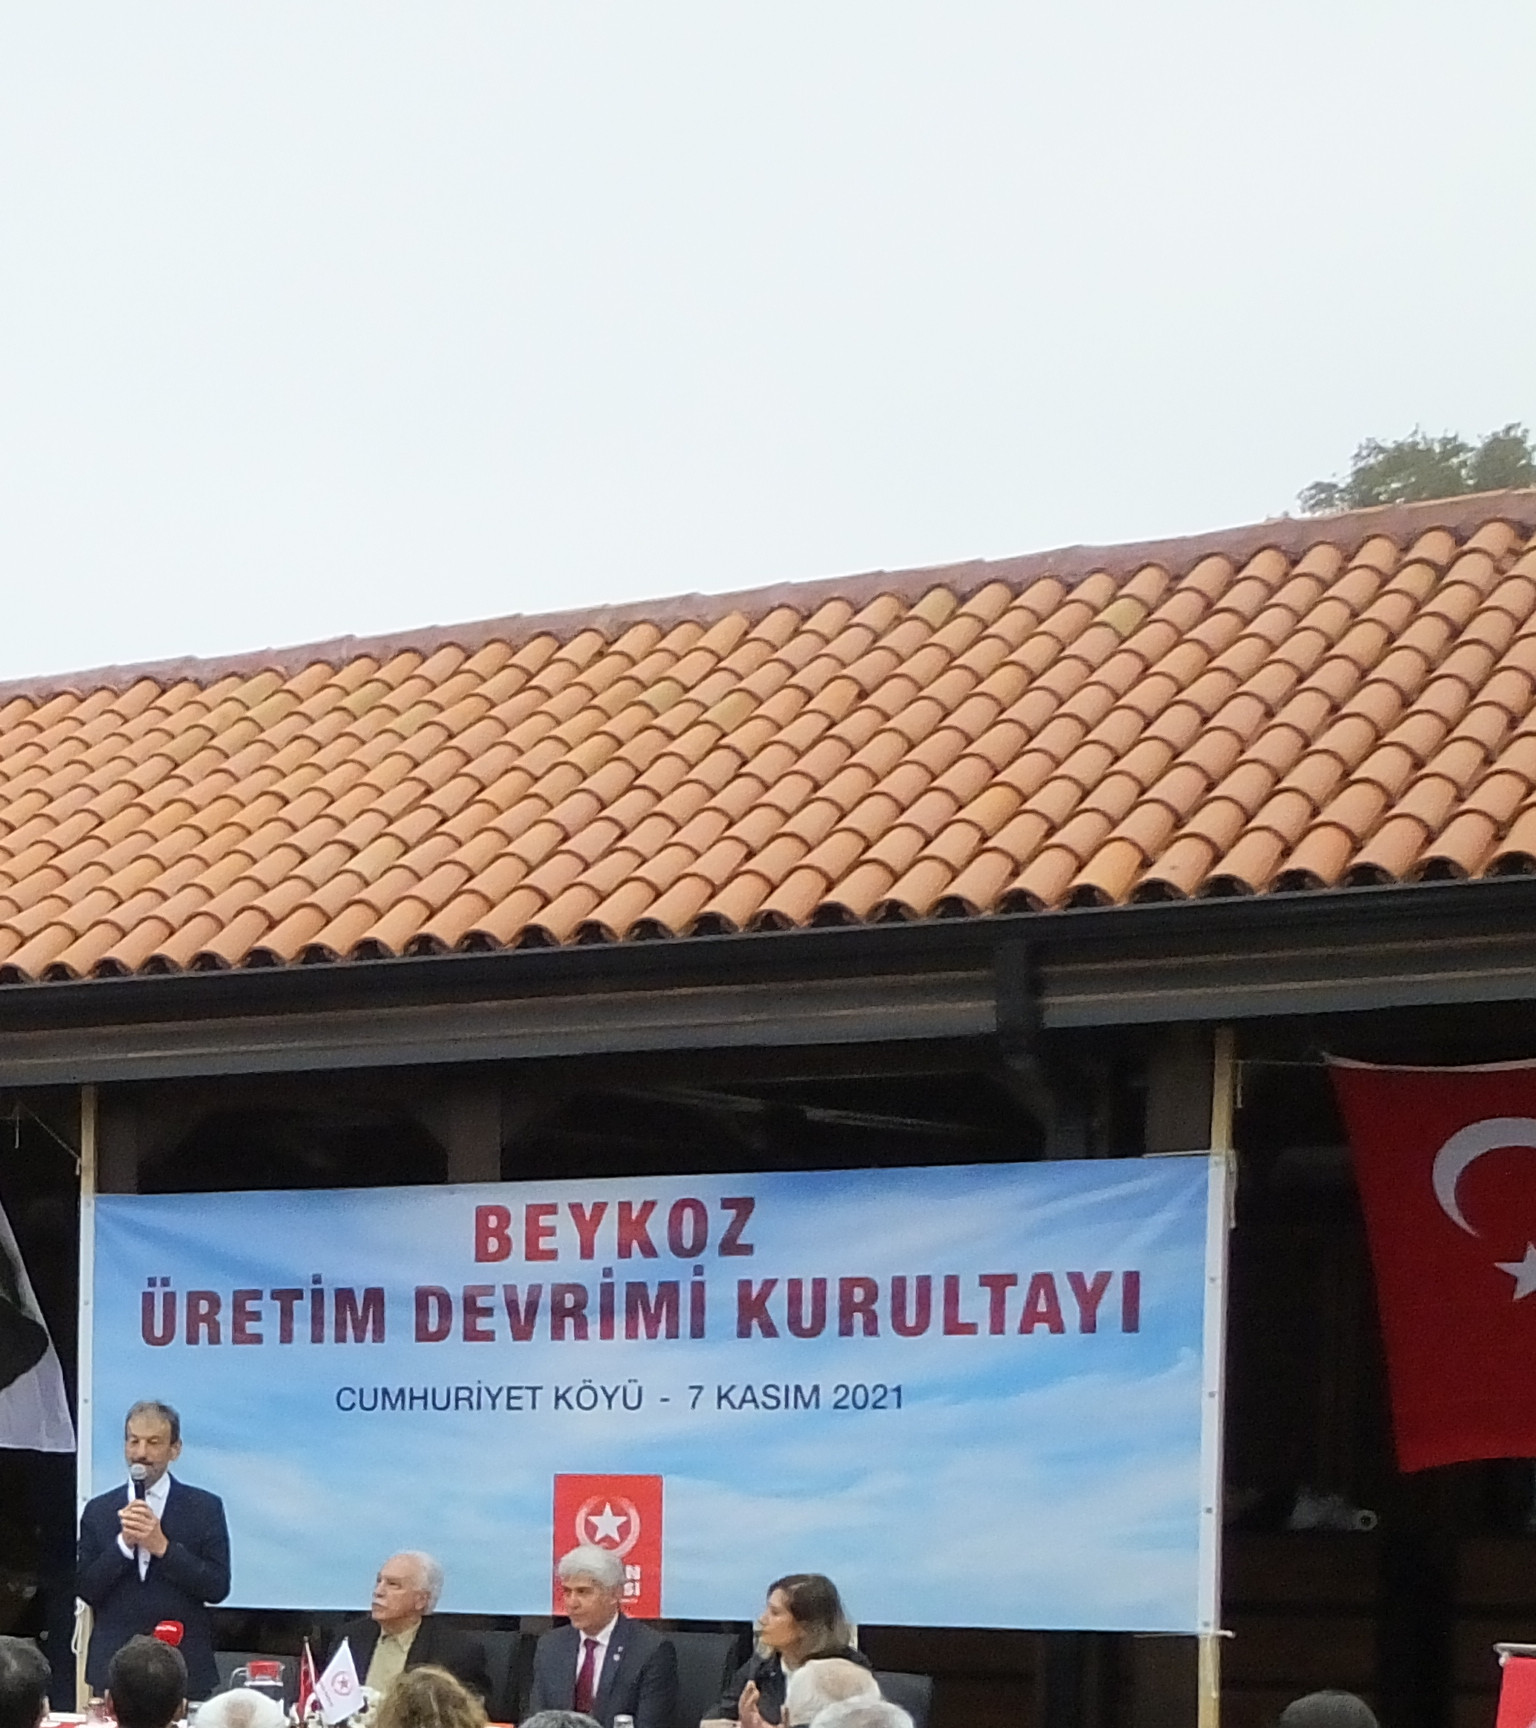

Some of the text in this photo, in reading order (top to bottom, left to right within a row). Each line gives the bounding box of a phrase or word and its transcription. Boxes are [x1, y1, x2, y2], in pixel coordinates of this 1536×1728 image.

[474, 1197, 756, 1263] BEYKOZ
[140, 1264, 1141, 1347] ÜRETİM DEVRİMİ KURULTAYI
[335, 1379, 544, 1413] CUMHURİYET
[554, 1378, 644, 1412] KÖYÜ
[688, 1384, 705, 1411] 7
[715, 1383, 821, 1411] KASIM
[832, 1383, 904, 1411] 2021
